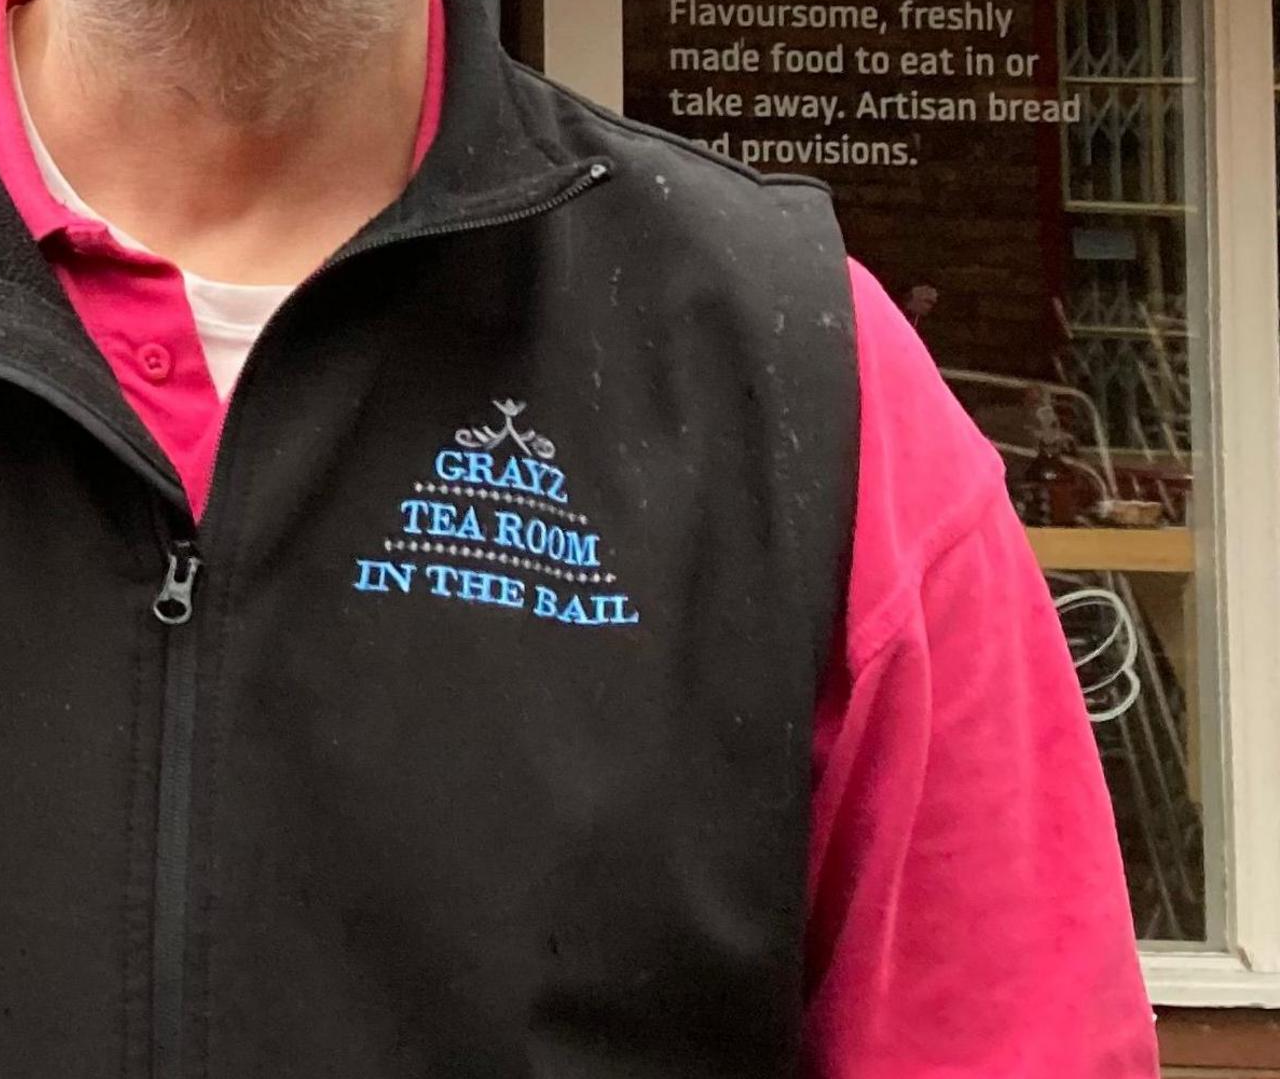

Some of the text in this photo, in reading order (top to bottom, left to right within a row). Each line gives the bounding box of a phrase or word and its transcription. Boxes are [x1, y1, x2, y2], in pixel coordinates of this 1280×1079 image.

[899, 0, 1013, 39] freshly
[670, 42, 1040, 77] made food to eat in or
[669, 86, 1081, 126] take away. Artisan bread
[741, 133, 918, 166] provisions.
[435, 450, 569, 503] GRAYZ
[400, 500, 601, 567] TEA ROOM
[353, 559, 640, 625] IN THE BAIL
